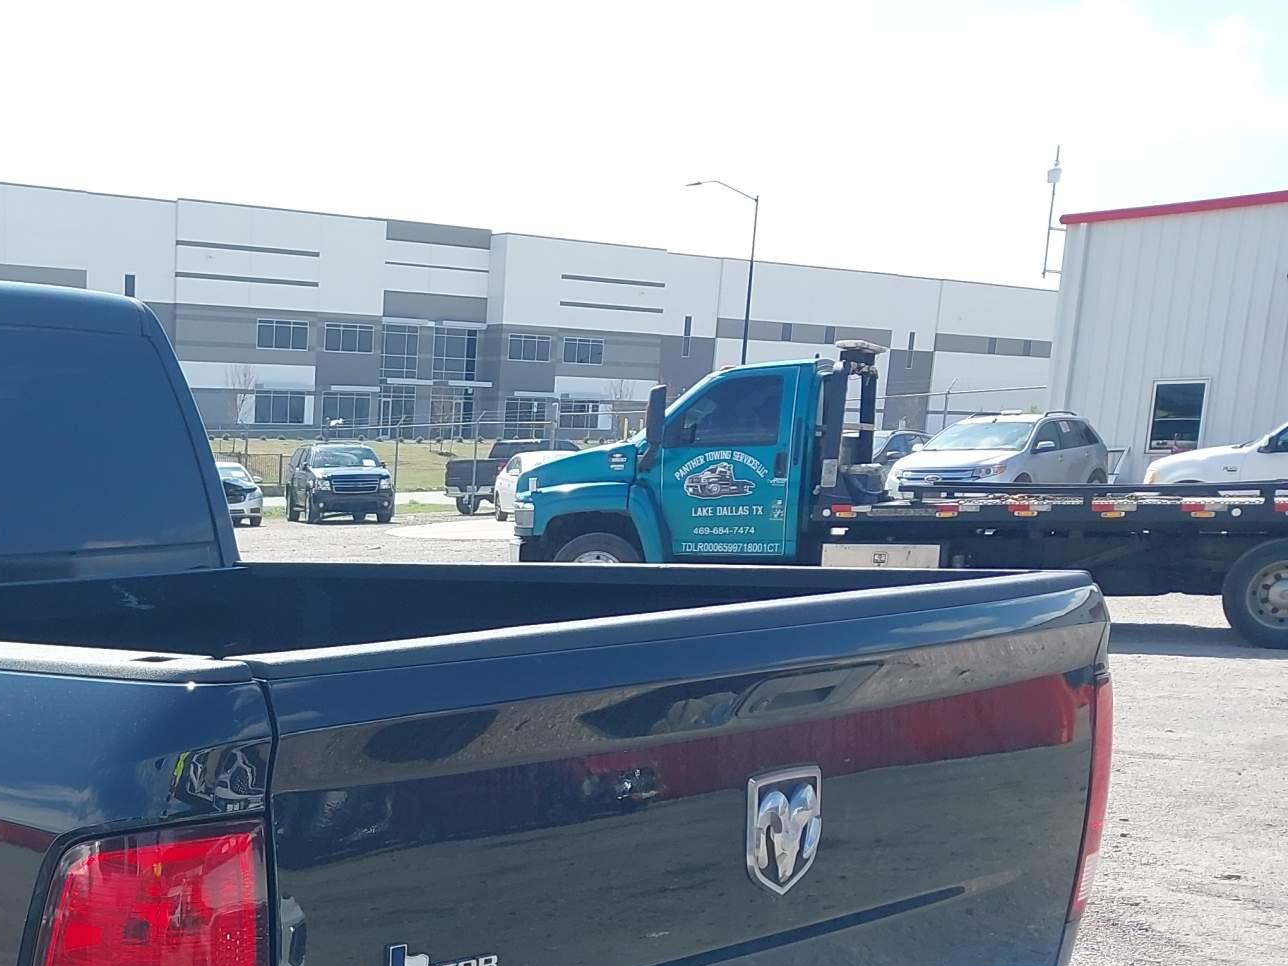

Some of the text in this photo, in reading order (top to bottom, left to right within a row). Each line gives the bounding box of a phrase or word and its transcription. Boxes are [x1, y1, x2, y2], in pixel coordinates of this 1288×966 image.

[674, 455, 706, 480] PANTHER
[705, 450, 732, 461] TOWING
[732, 451, 759, 472] SERVICES
[691, 505, 764, 517] LAKE DALLAS TX
[693, 526, 755, 535] 469-684-7474
